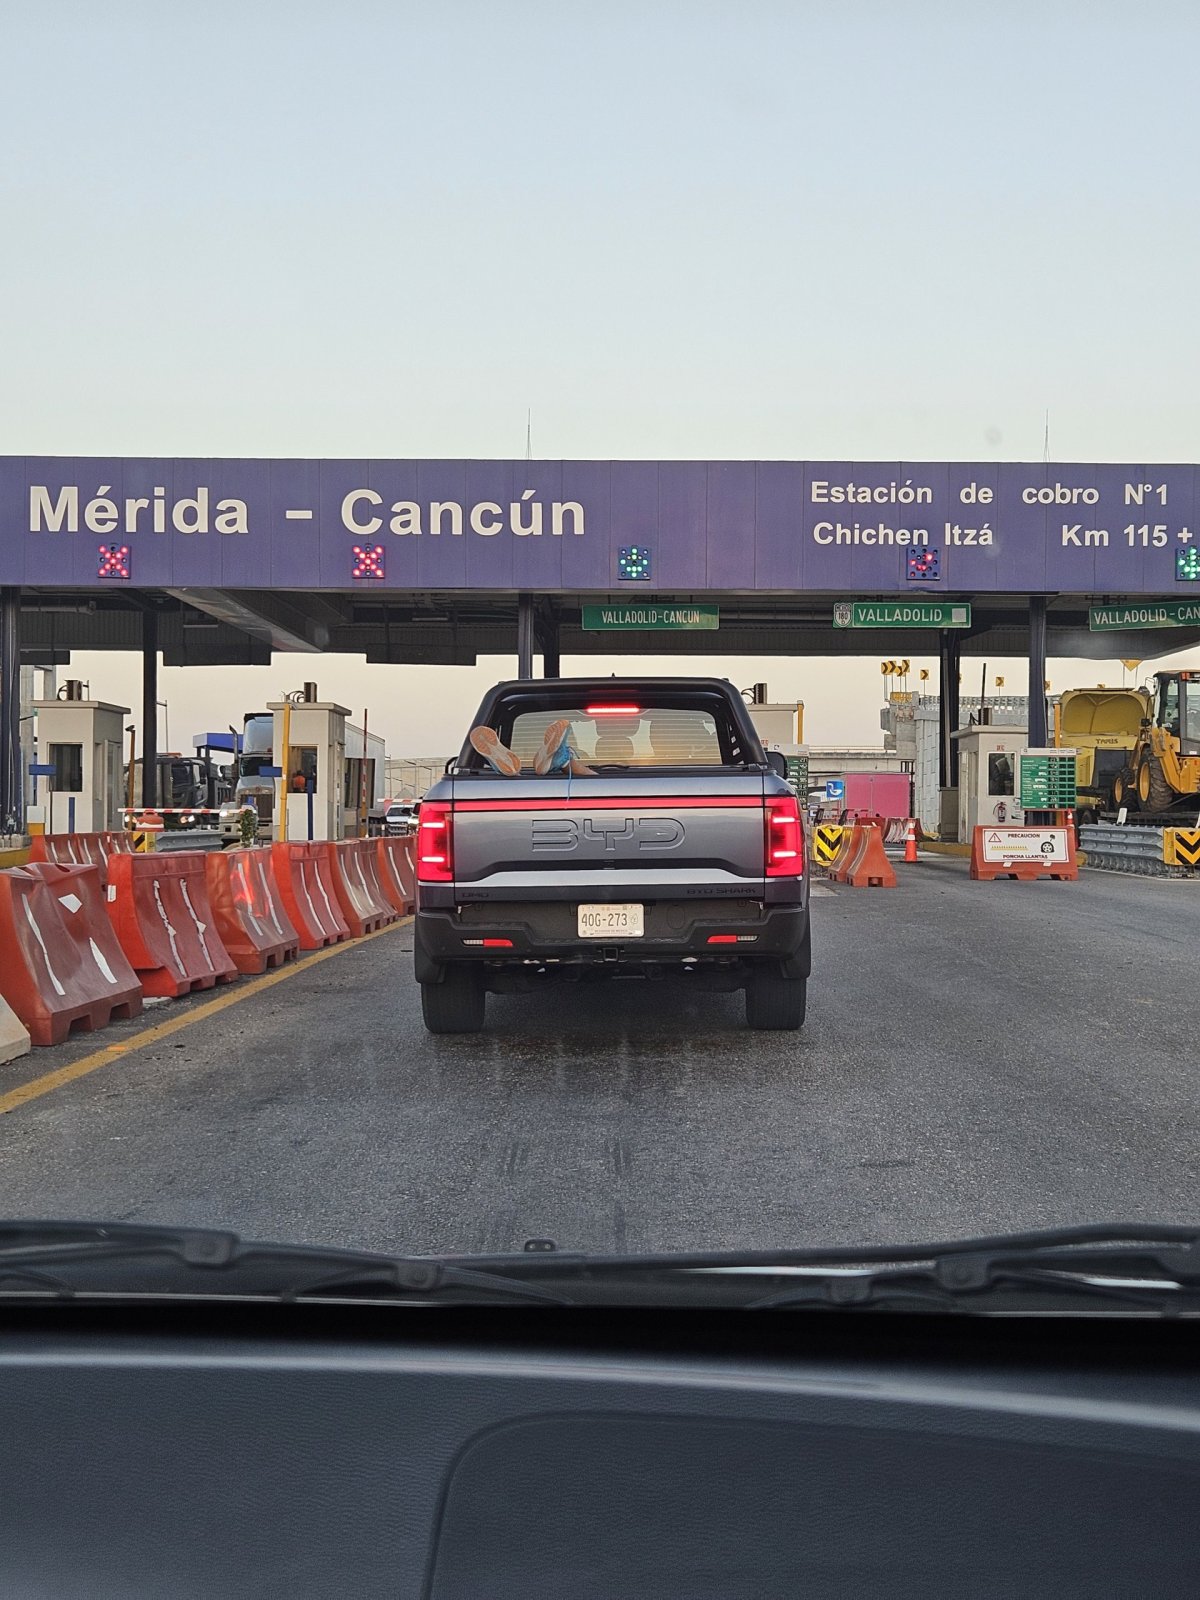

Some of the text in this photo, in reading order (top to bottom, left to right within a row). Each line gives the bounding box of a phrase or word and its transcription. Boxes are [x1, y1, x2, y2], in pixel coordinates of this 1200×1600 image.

[811, 479, 933, 504] Estación
[959, 482, 994, 504] de
[1021, 482, 1100, 505] cobro
[29, 485, 249, 534] Mérida
[341, 488, 586, 536] Cancún
[813, 521, 929, 546] Chichen
[944, 522, 994, 546] Itzá
[1061, 524, 1109, 547] Km
[1123, 524, 1168, 548] 115
[858, 609, 942, 621] VALLADOLID
[531, 818, 686, 852] BYD
[581, 912, 628, 927] 40G-273
